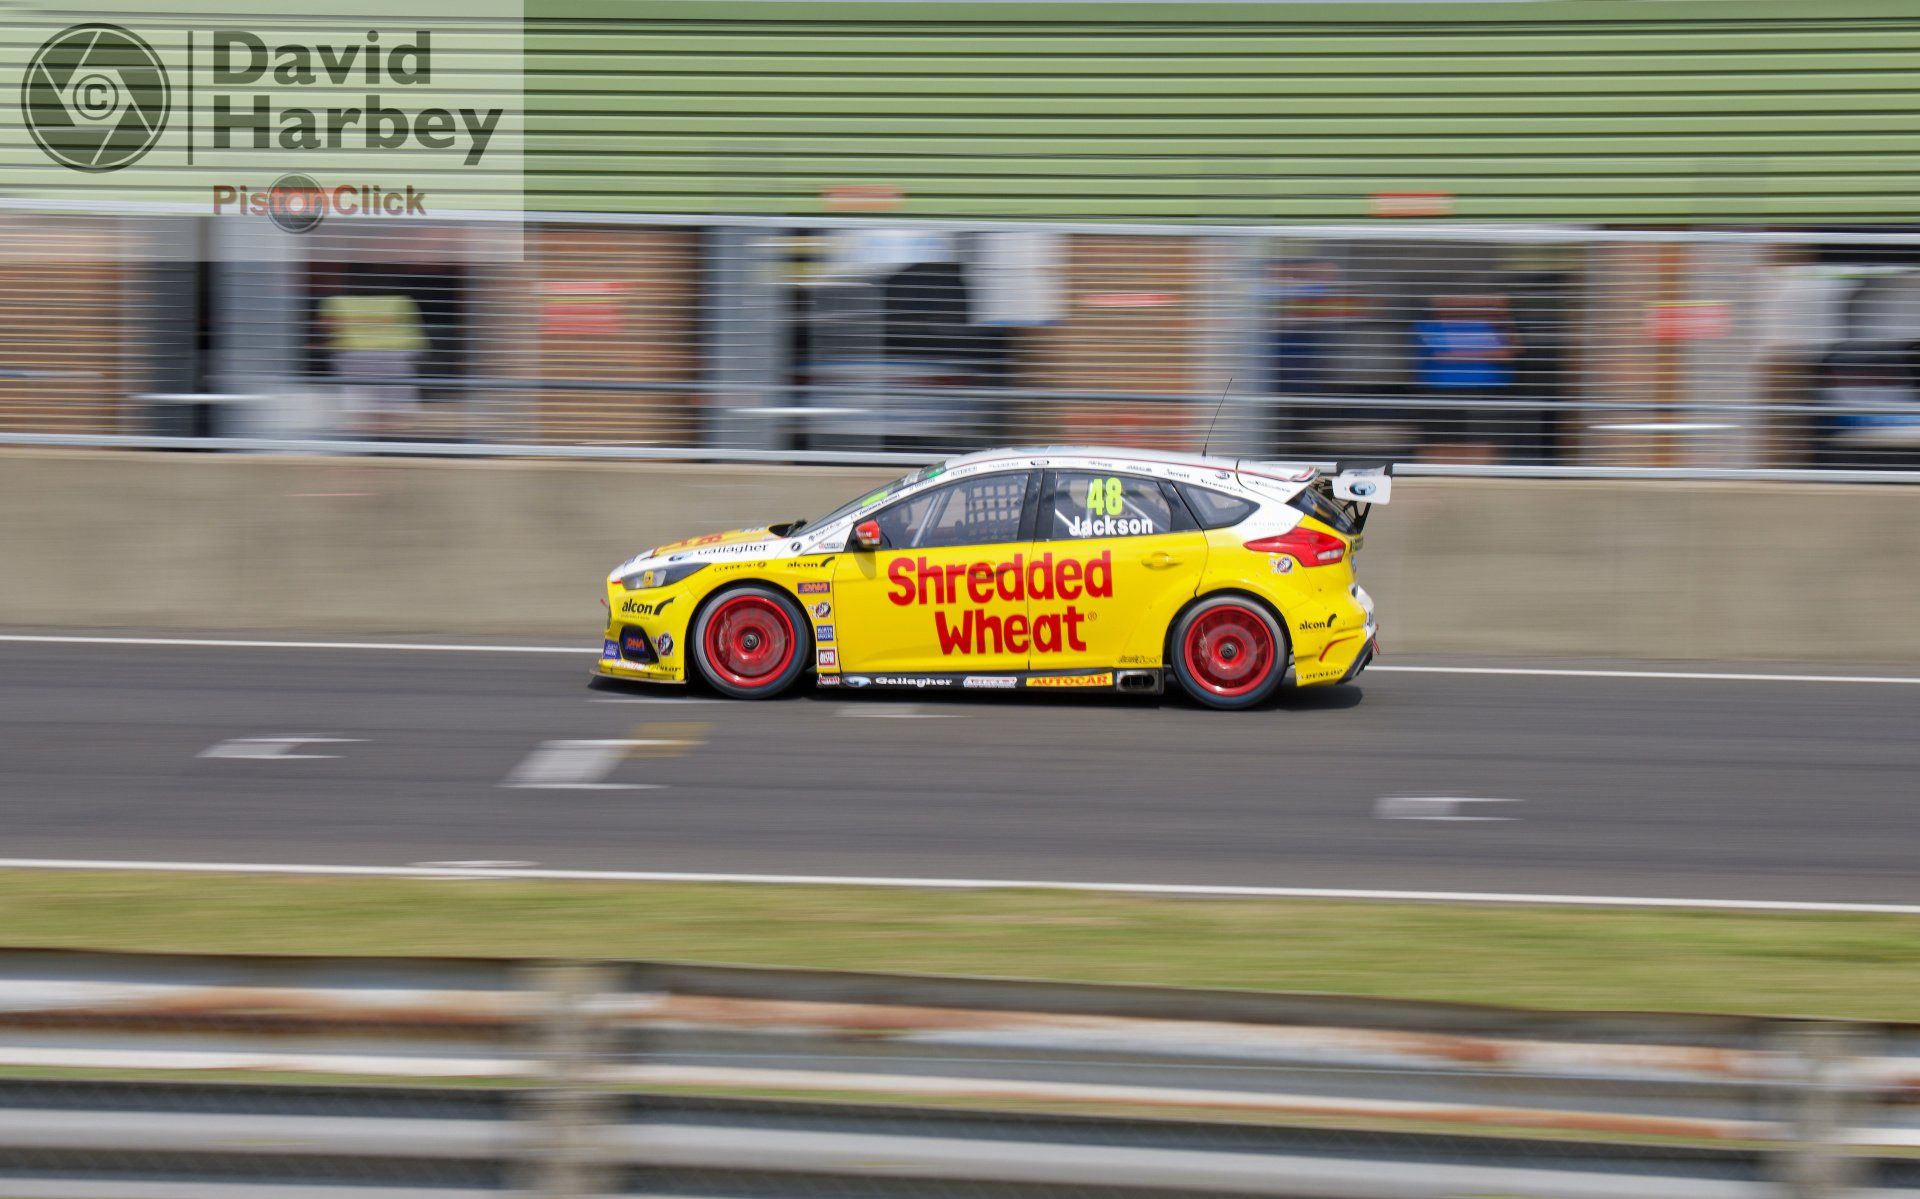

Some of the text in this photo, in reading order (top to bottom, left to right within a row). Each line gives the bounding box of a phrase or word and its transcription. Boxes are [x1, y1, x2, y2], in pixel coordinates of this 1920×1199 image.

[1087, 477, 1123, 516] 48
[1069, 515, 1153, 537] Jackson
[697, 543, 767, 556] Gallagher
[888, 550, 1113, 606] Shredded
[621, 598, 653, 616] alcon
[1299, 620, 1326, 630] alcon
[875, 676, 953, 688] Gallagher
[1031, 673, 1109, 687] AUTOCAR
